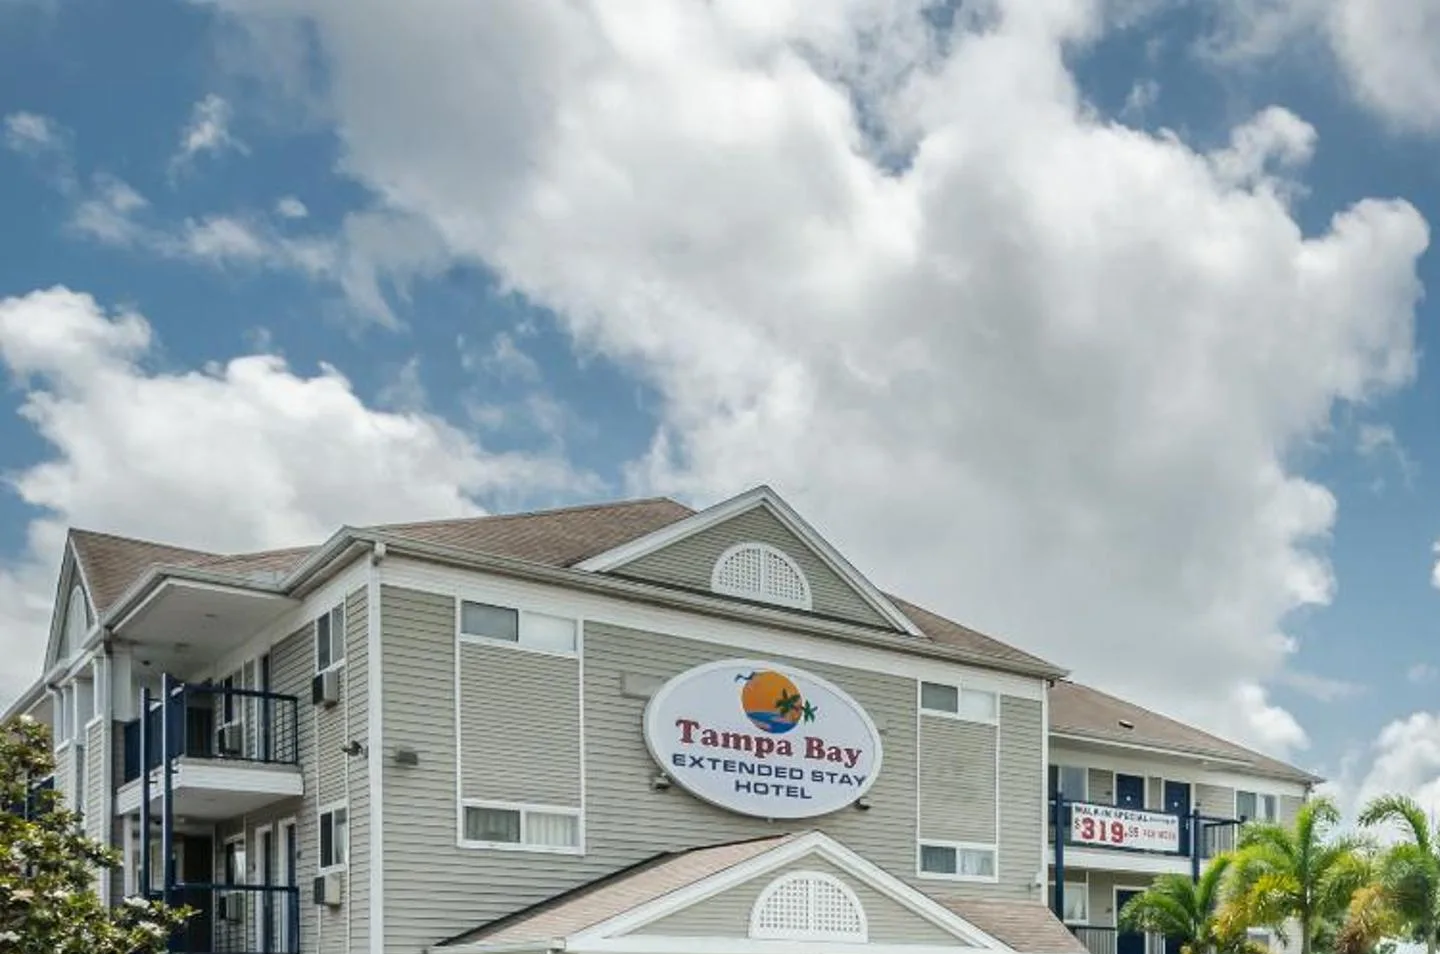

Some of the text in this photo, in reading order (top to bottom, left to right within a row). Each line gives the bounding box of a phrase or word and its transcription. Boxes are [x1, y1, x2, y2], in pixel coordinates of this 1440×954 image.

[675, 718, 862, 768] Tampa Bay
[672, 753, 867, 787] EXTENDED STAY
[735, 780, 812, 799] HOTEL
